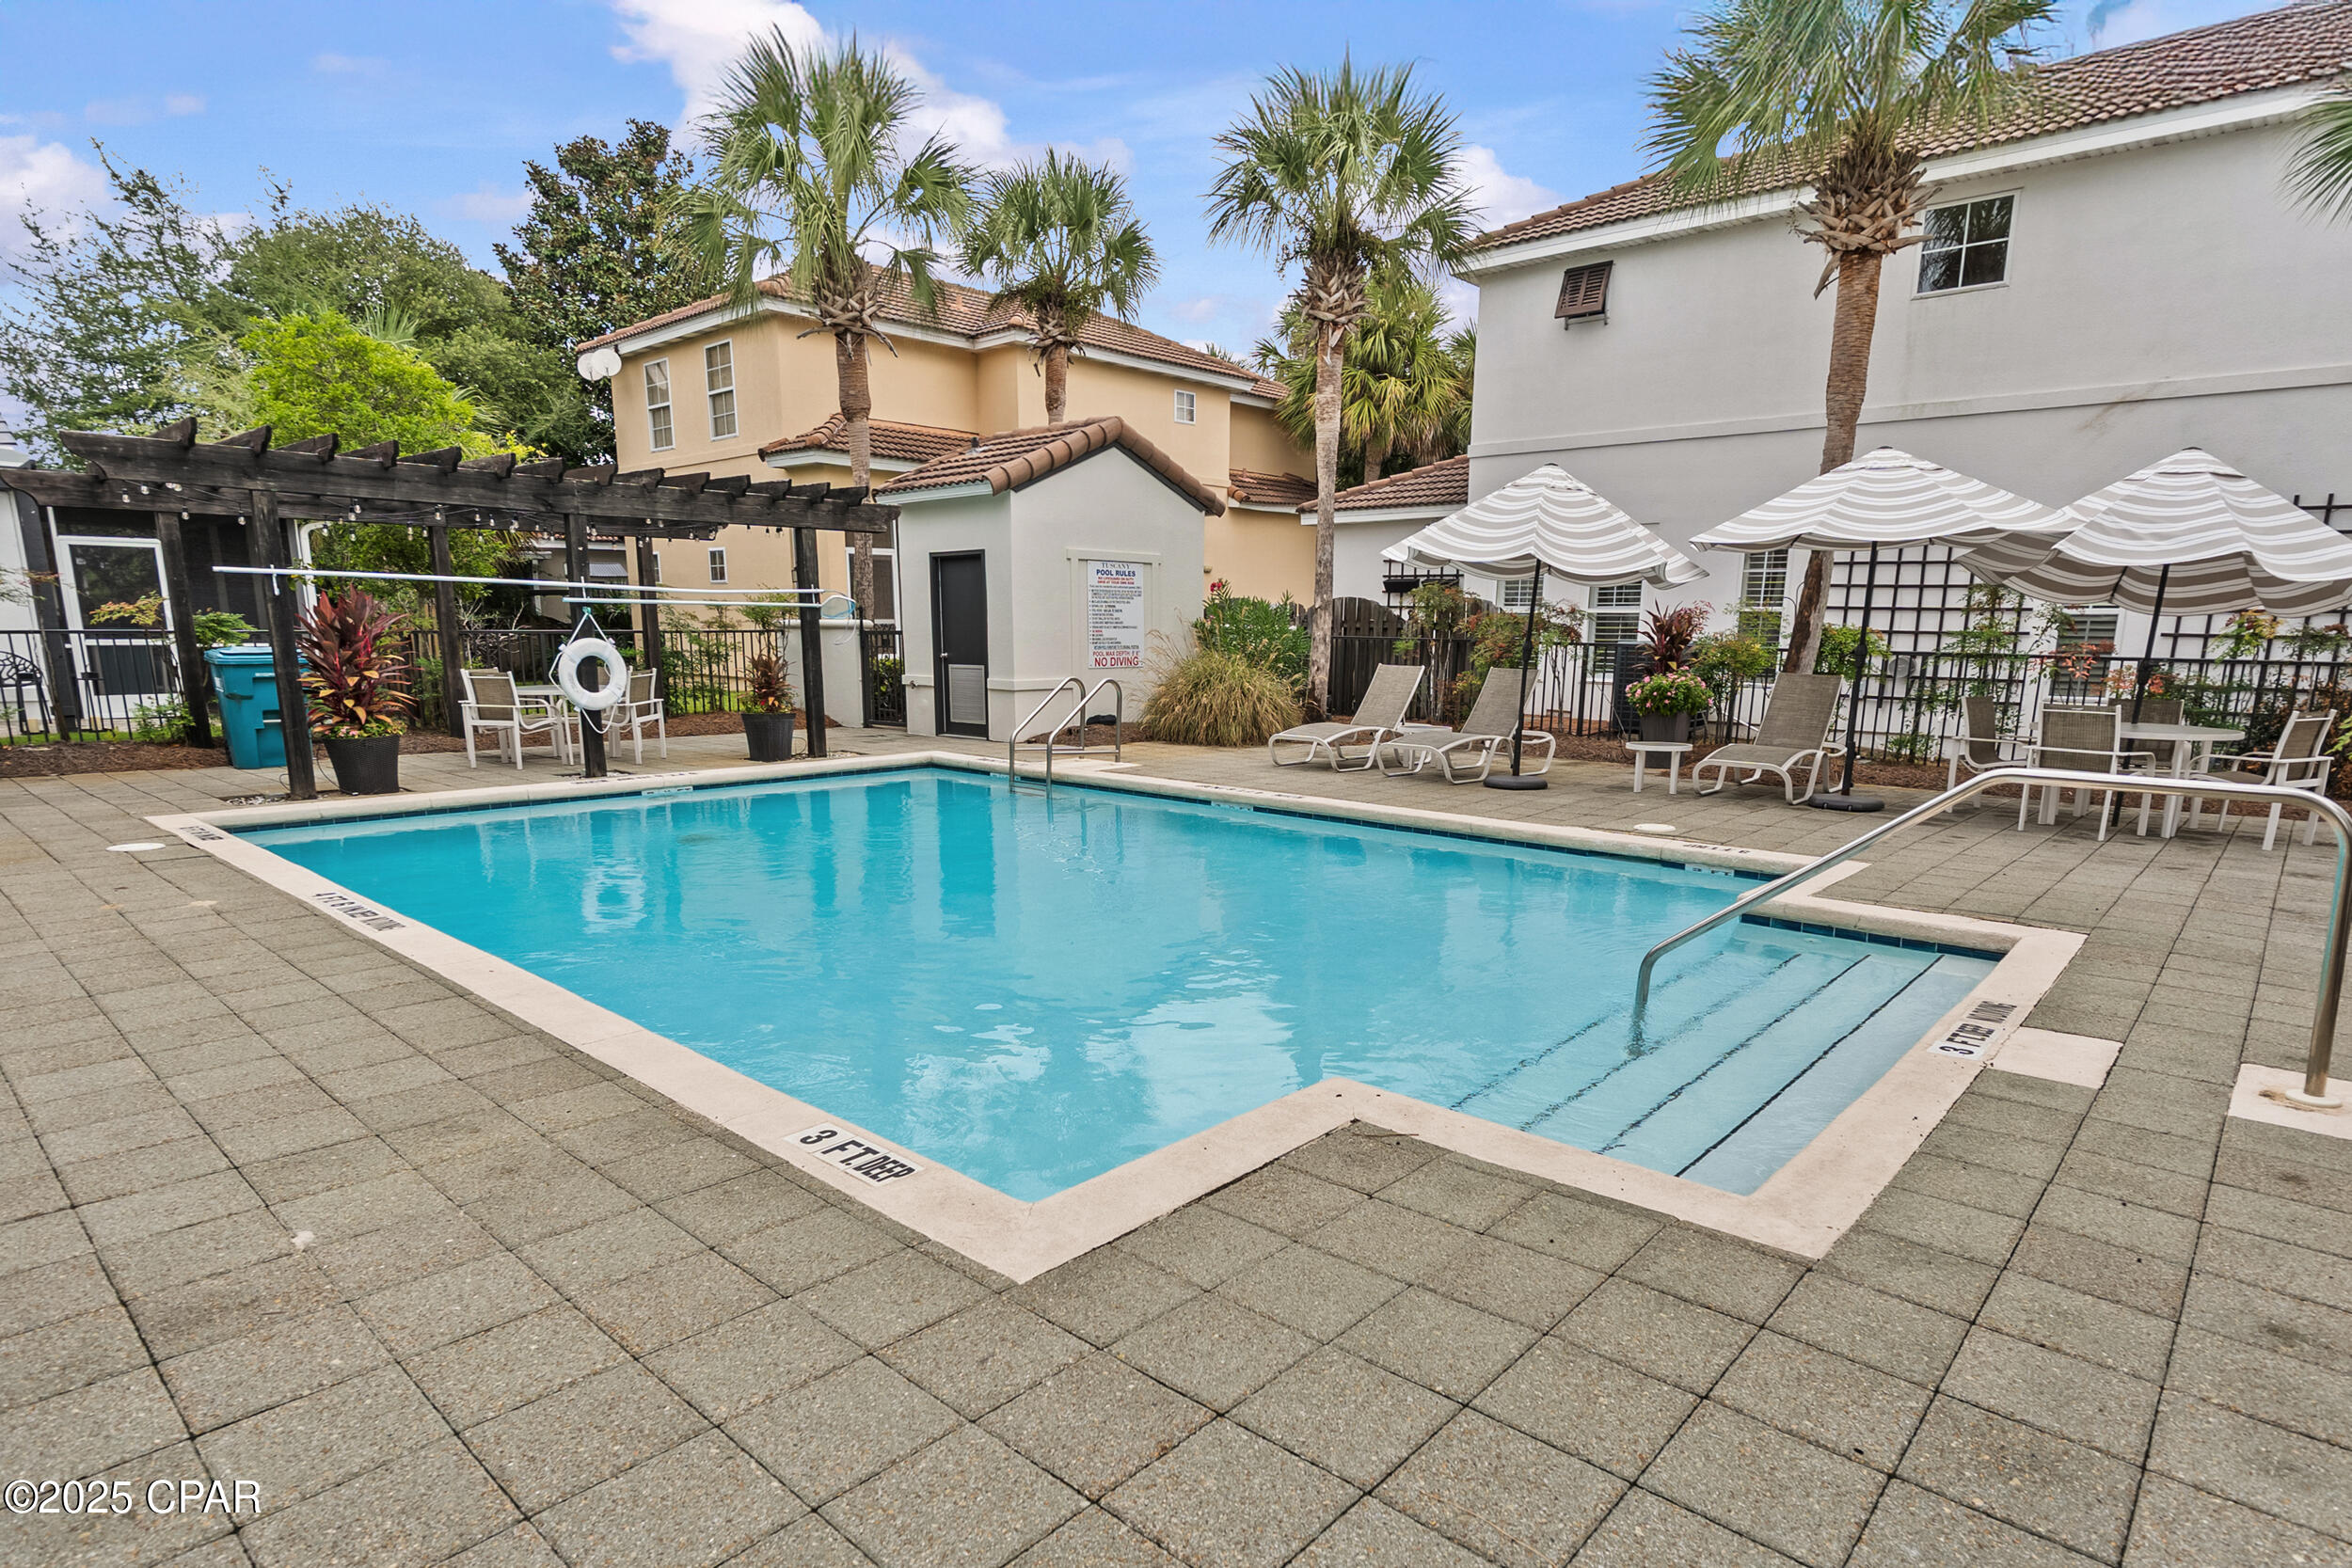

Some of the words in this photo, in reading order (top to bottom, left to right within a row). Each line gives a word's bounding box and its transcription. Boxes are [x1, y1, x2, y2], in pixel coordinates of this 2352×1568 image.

[1094, 657, 1108, 667] NO
[1110, 657, 1139, 666] DIVING
[1939, 1045, 1975, 1055] 3
[799, 1129, 838, 1145] 3
[851, 1155, 916, 1182] DEEP
